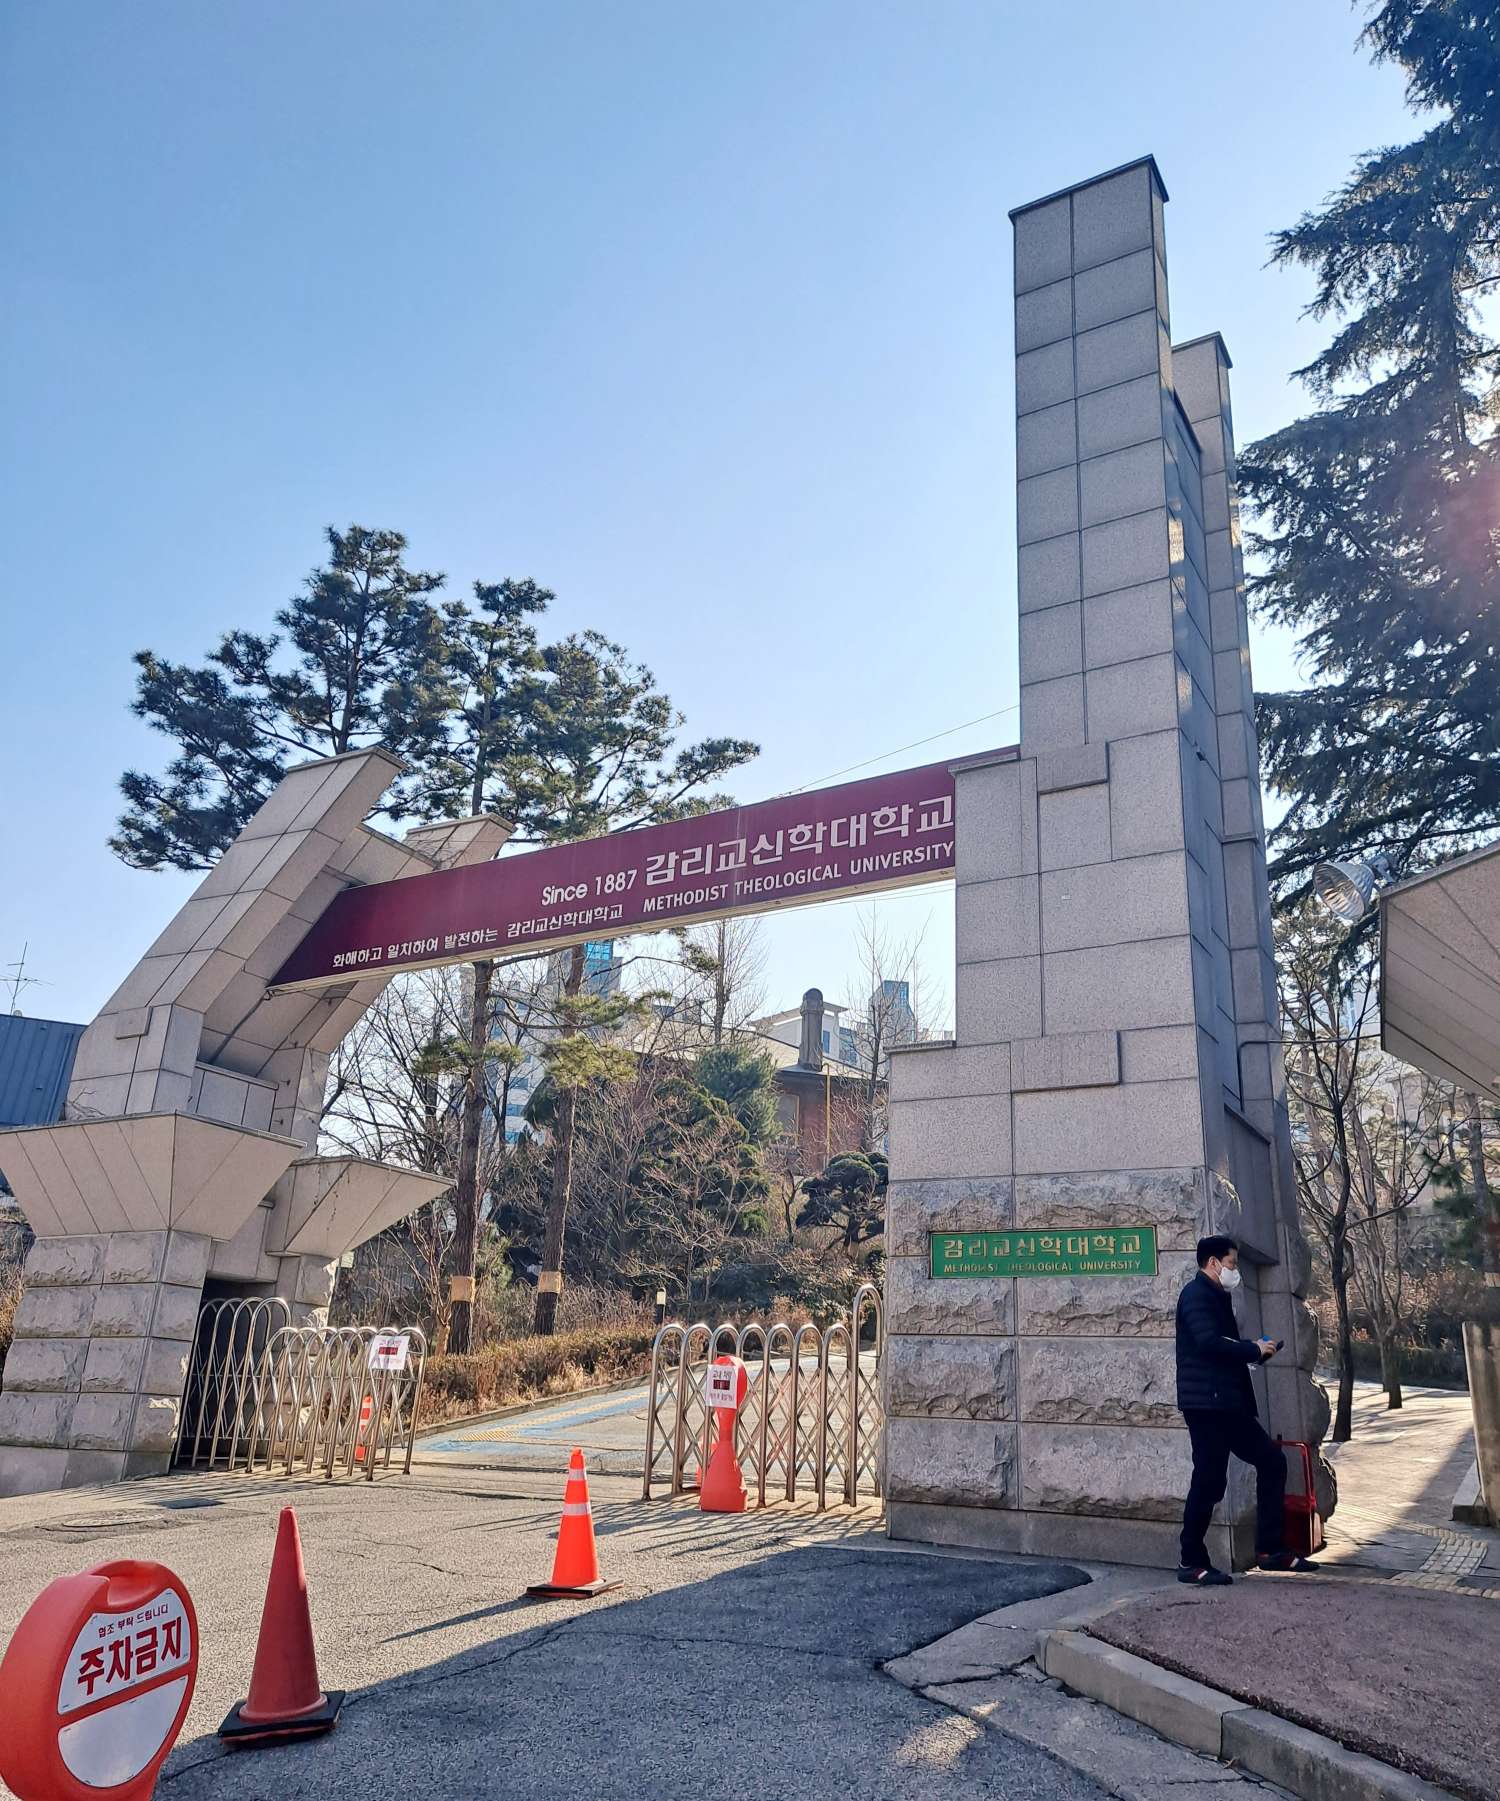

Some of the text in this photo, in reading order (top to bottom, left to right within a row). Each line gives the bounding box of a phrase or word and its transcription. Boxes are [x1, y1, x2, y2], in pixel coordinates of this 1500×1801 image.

[646, 796, 954, 886] 감리교신학대학교
[541, 869, 638, 906] Since 1887
[643, 841, 954, 913] METHODIST THEOLOGICAL UNIVERSITY
[387, 937, 439, 959] 일치하여
[444, 927, 498, 950] 발전하는
[507, 904, 623, 937] 감리교신학대학교
[944, 1235, 1141, 1258] 감리교신학대학교
[1079, 1259, 1142, 1272] UNIVERSITY
[77, 1616, 182, 1696] 주차금지
